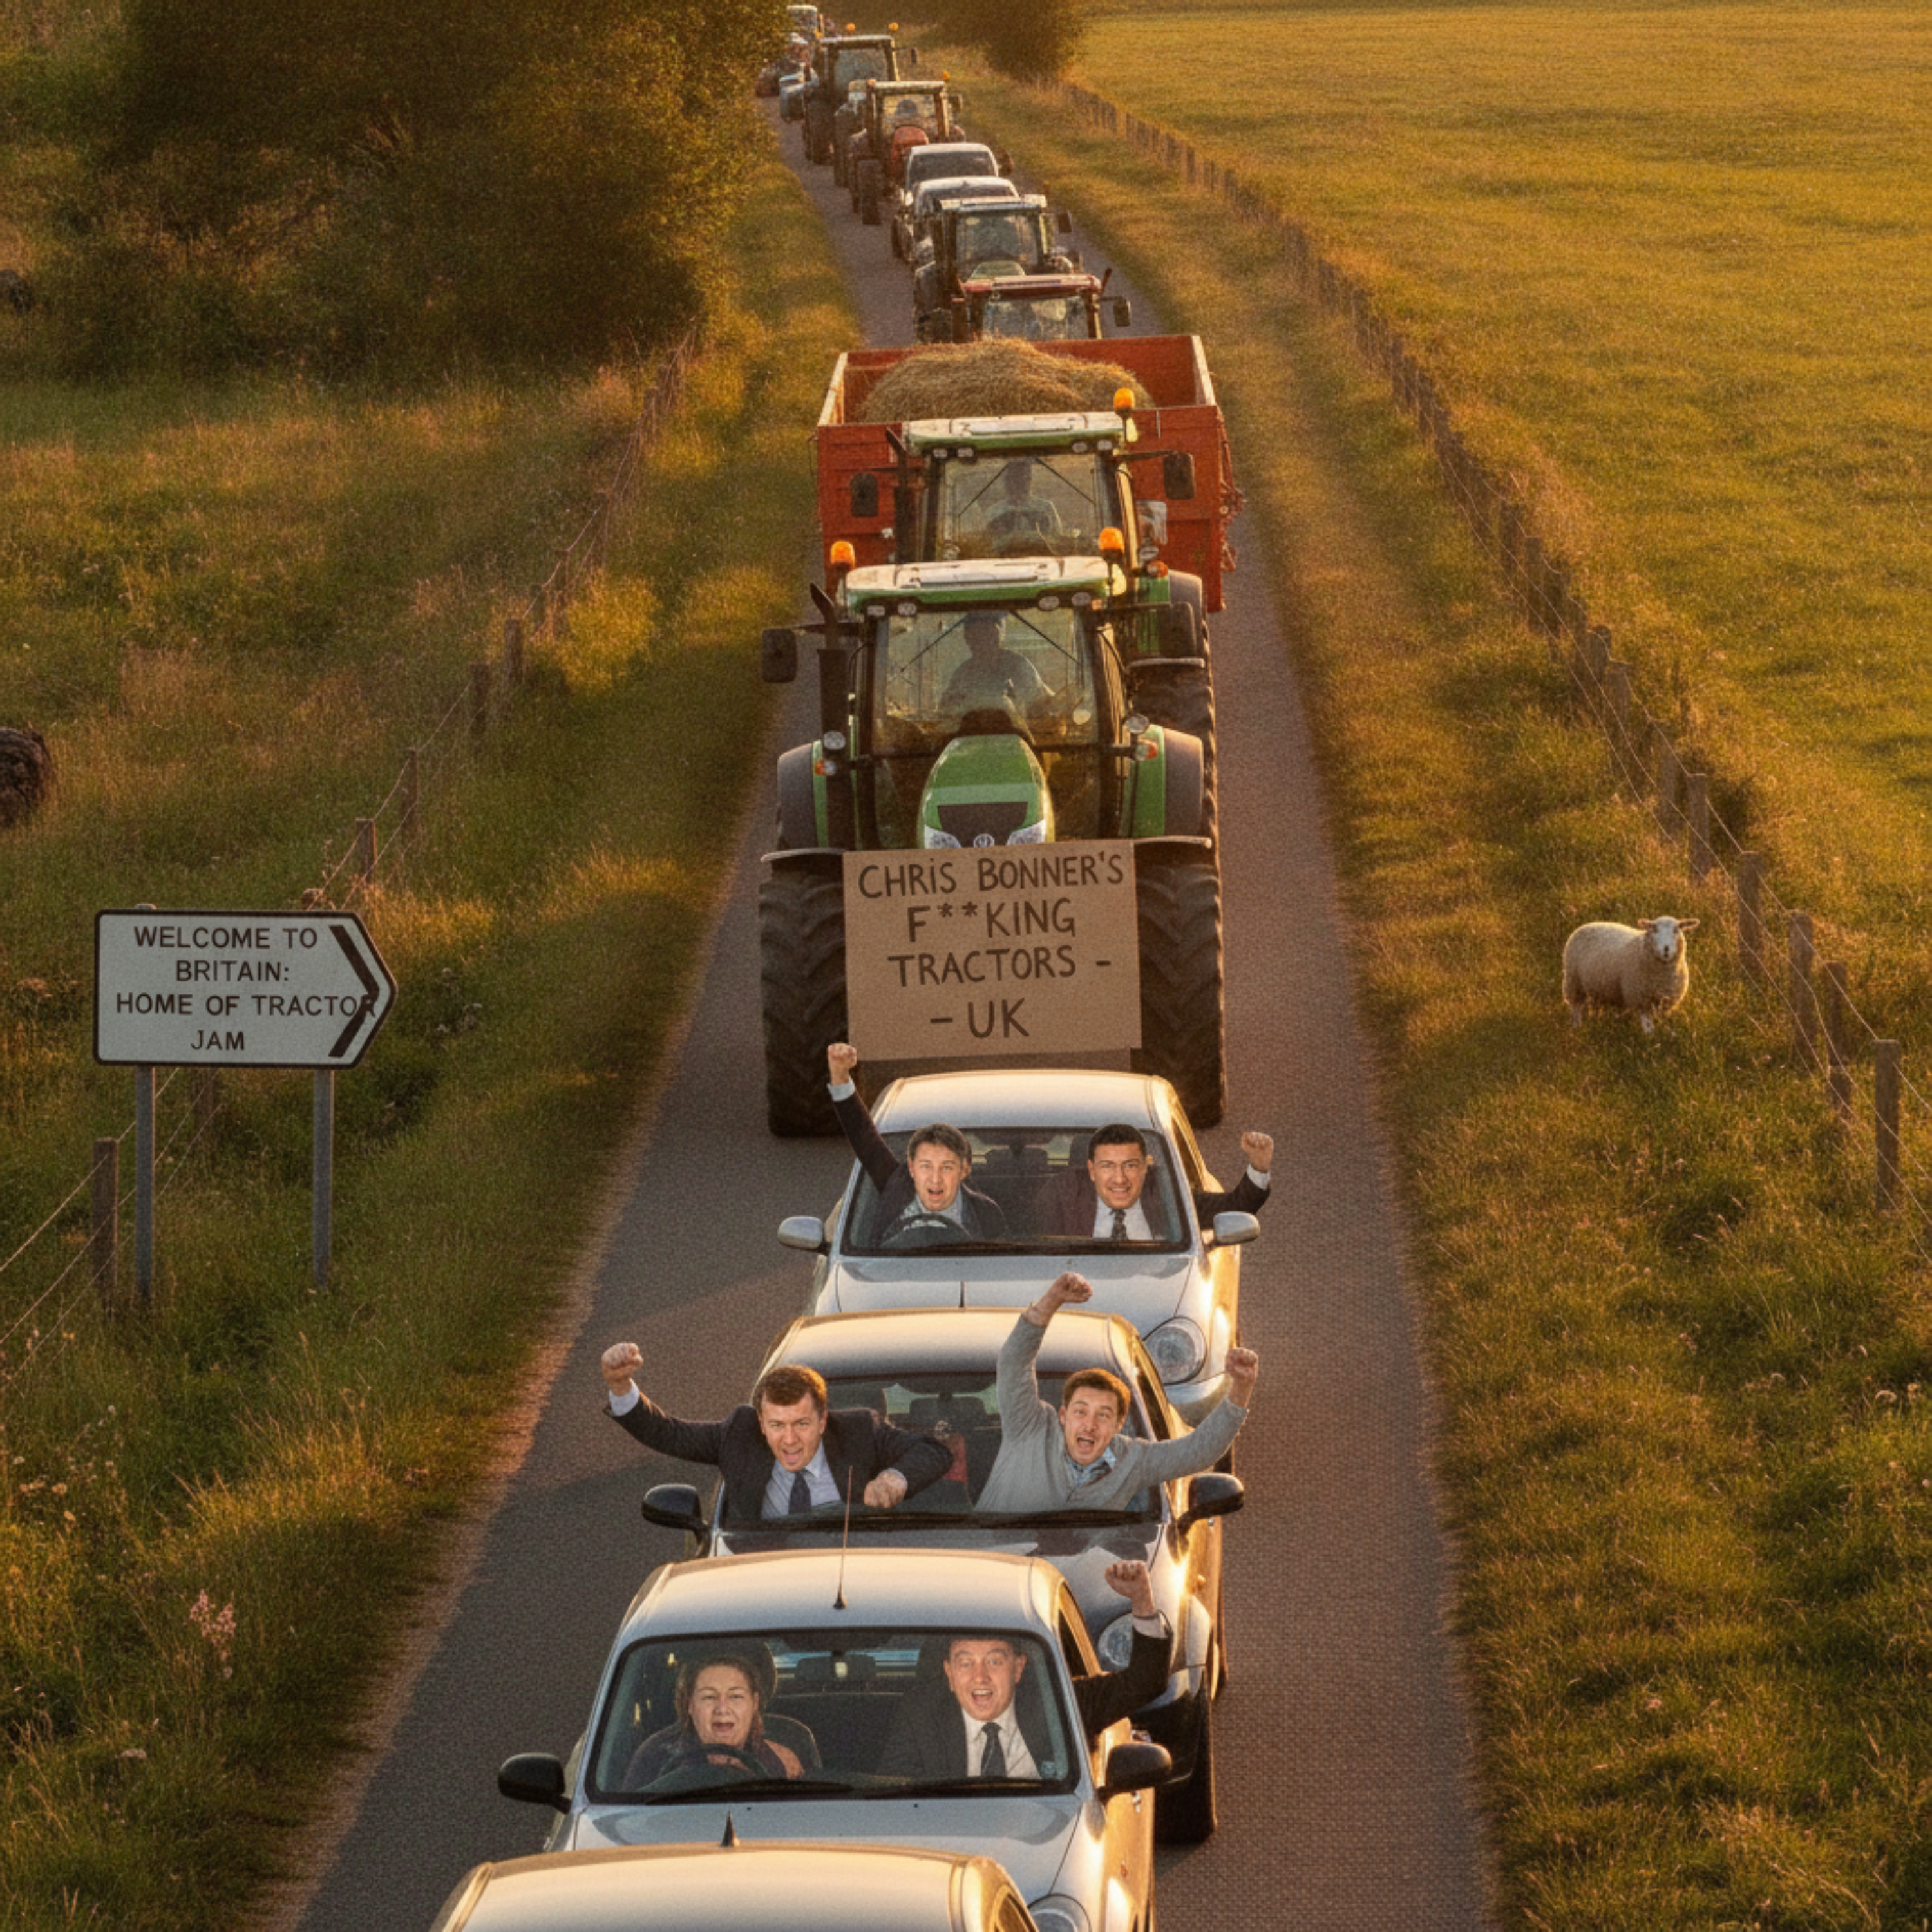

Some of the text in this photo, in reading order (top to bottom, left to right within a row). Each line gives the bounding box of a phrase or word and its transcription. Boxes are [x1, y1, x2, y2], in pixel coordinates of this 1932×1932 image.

[977, 851, 1124, 892] BONNER'S
[134, 926, 317, 949] WELCOME TO
[176, 960, 289, 982] BRITAIN:
[888, 945, 1076, 987] TRACTORS
[117, 993, 193, 1015] HOME
[205, 996, 240, 1016] OF
[191, 1030, 245, 1051] JAM
